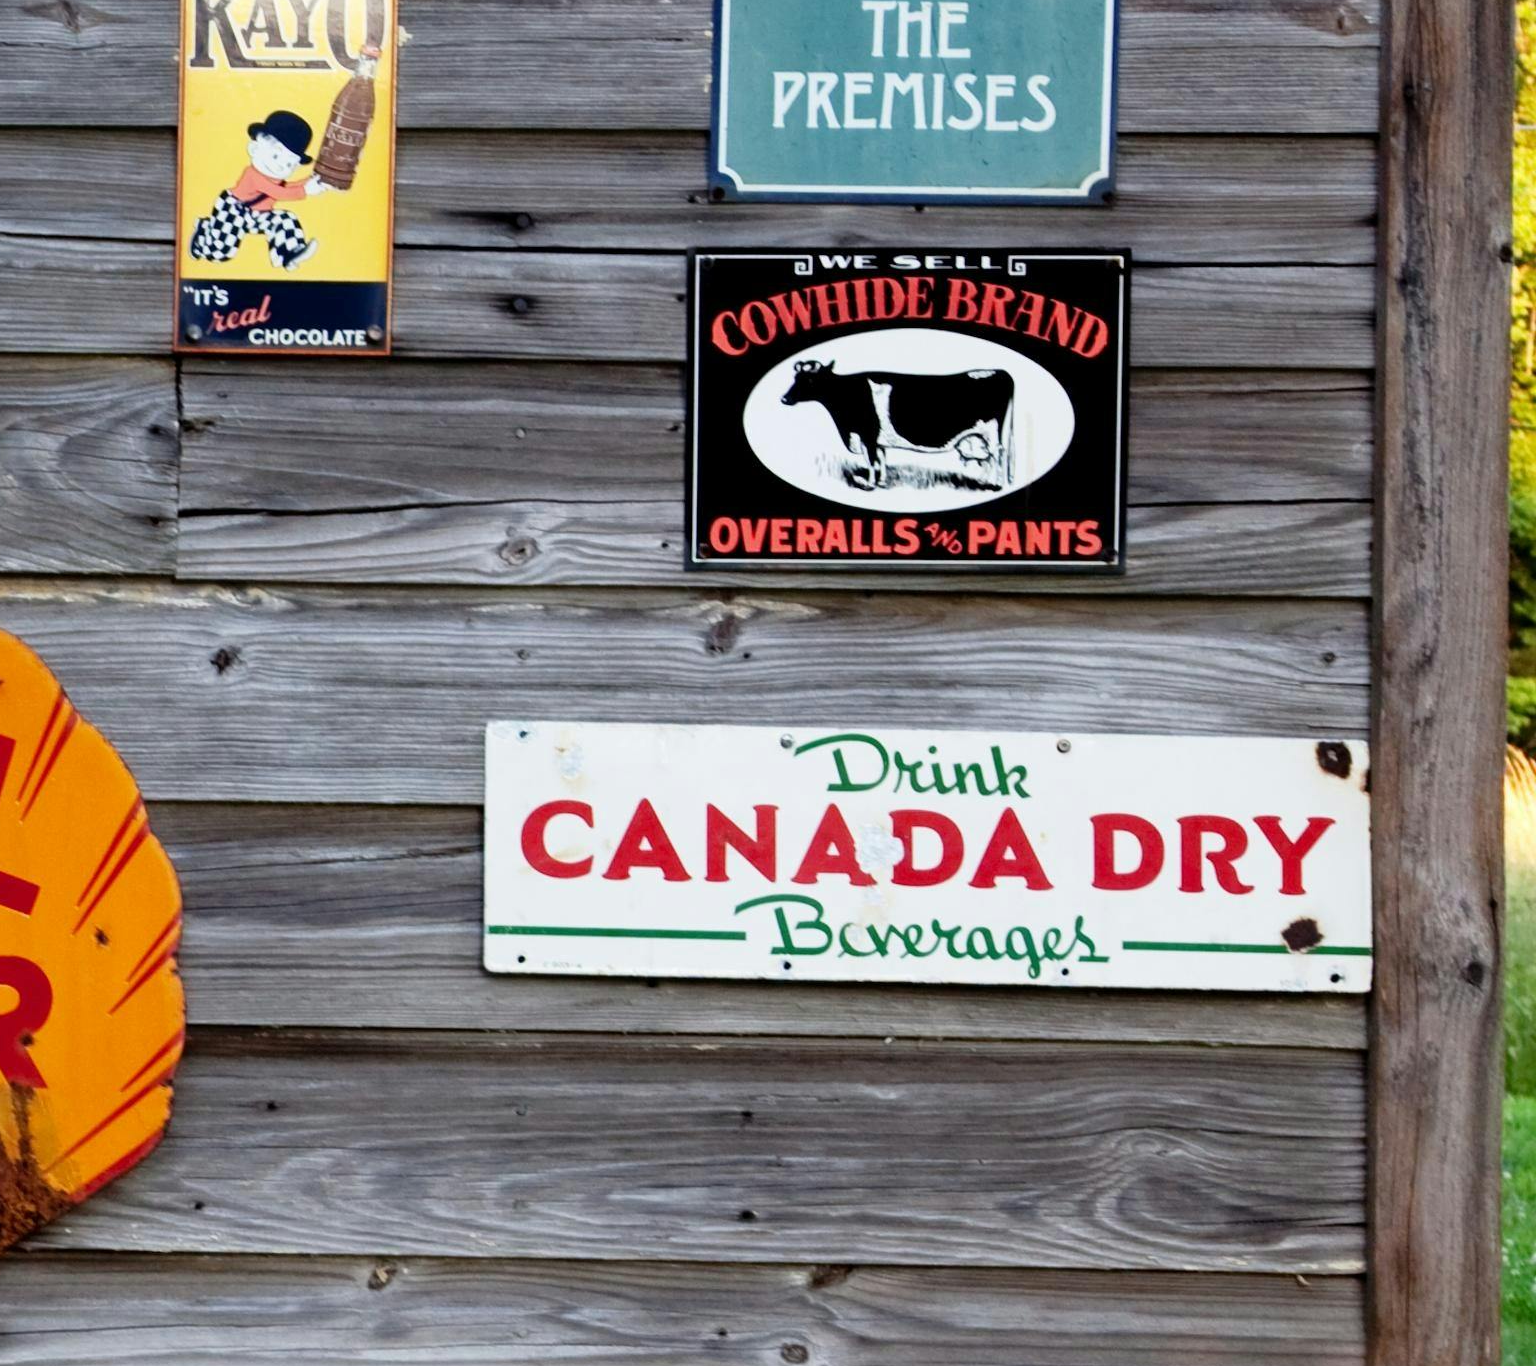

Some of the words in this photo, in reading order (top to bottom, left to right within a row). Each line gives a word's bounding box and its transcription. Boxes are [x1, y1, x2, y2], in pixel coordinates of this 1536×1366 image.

[861, 0, 972, 59] THE
[771, 71, 1058, 133] PREMISES
[819, 255, 877, 269] WE
[889, 255, 1003, 271] SELL
[206, 294, 272, 335] real
[247, 328, 368, 346] CHOCOLATE
[711, 276, 935, 357] COWHIDE
[943, 277, 1109, 359] BRAND
[709, 516, 921, 554] OVERALLS
[924, 522, 963, 555] AND
[967, 519, 1104, 556] PANTS
[794, 733, 1033, 799] Drink
[519, 797, 1055, 892] CANADA
[1089, 813, 1337, 896] DRY
[734, 894, 1111, 979] Beverages
